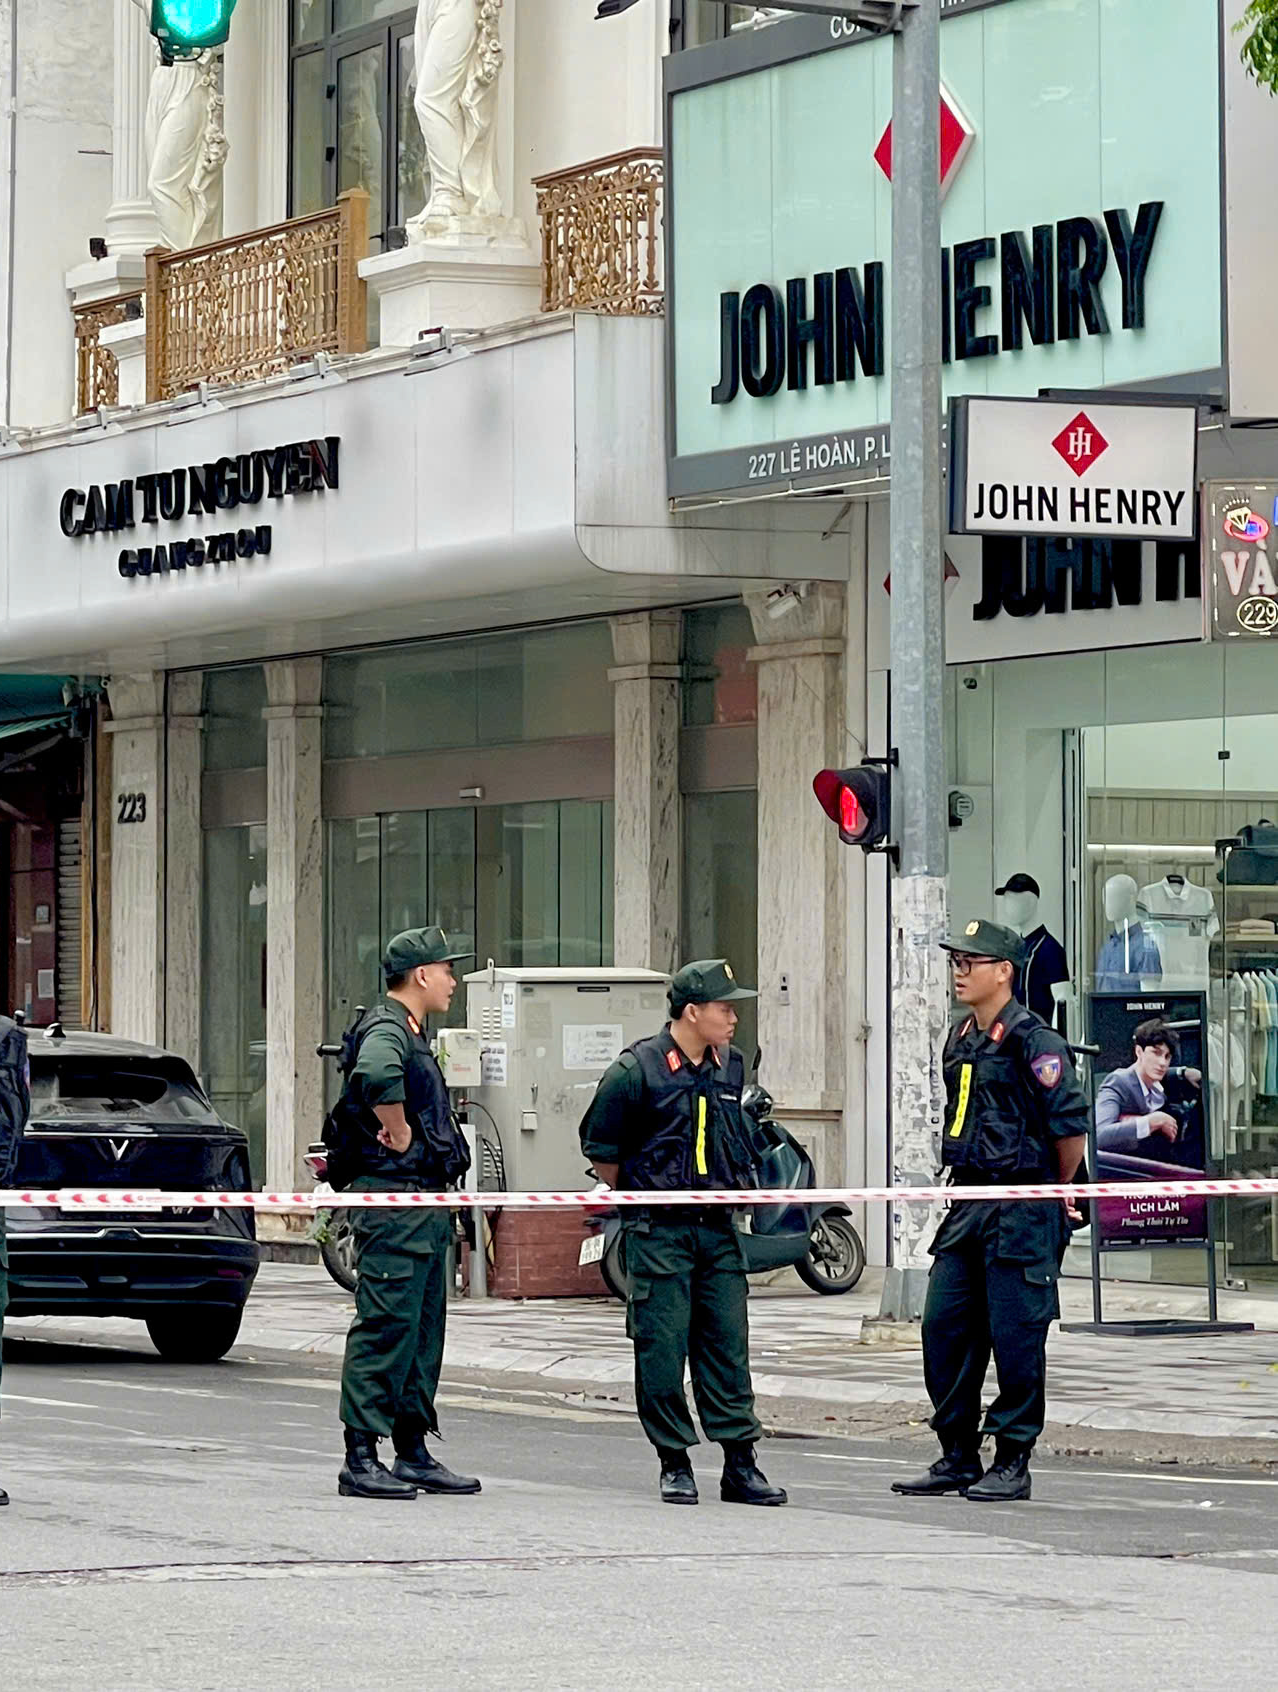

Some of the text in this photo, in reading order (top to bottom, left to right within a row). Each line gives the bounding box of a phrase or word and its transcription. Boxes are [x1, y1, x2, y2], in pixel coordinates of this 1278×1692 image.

[712, 200, 1165, 404] JOHN ENRY
[748, 454, 775, 478] 227
[779, 443, 802, 474] LÊ
[806, 436, 860, 468] HOÀN,
[865, 436, 878, 461] P.
[60, 479, 135, 537] CAM
[188, 436, 340, 515] NGUYEN
[973, 483, 1186, 526] JOHN HENRY
[1221, 538, 1278, 596] VÀ
[1243, 603, 1277, 625] 229
[117, 792, 146, 824] 223
